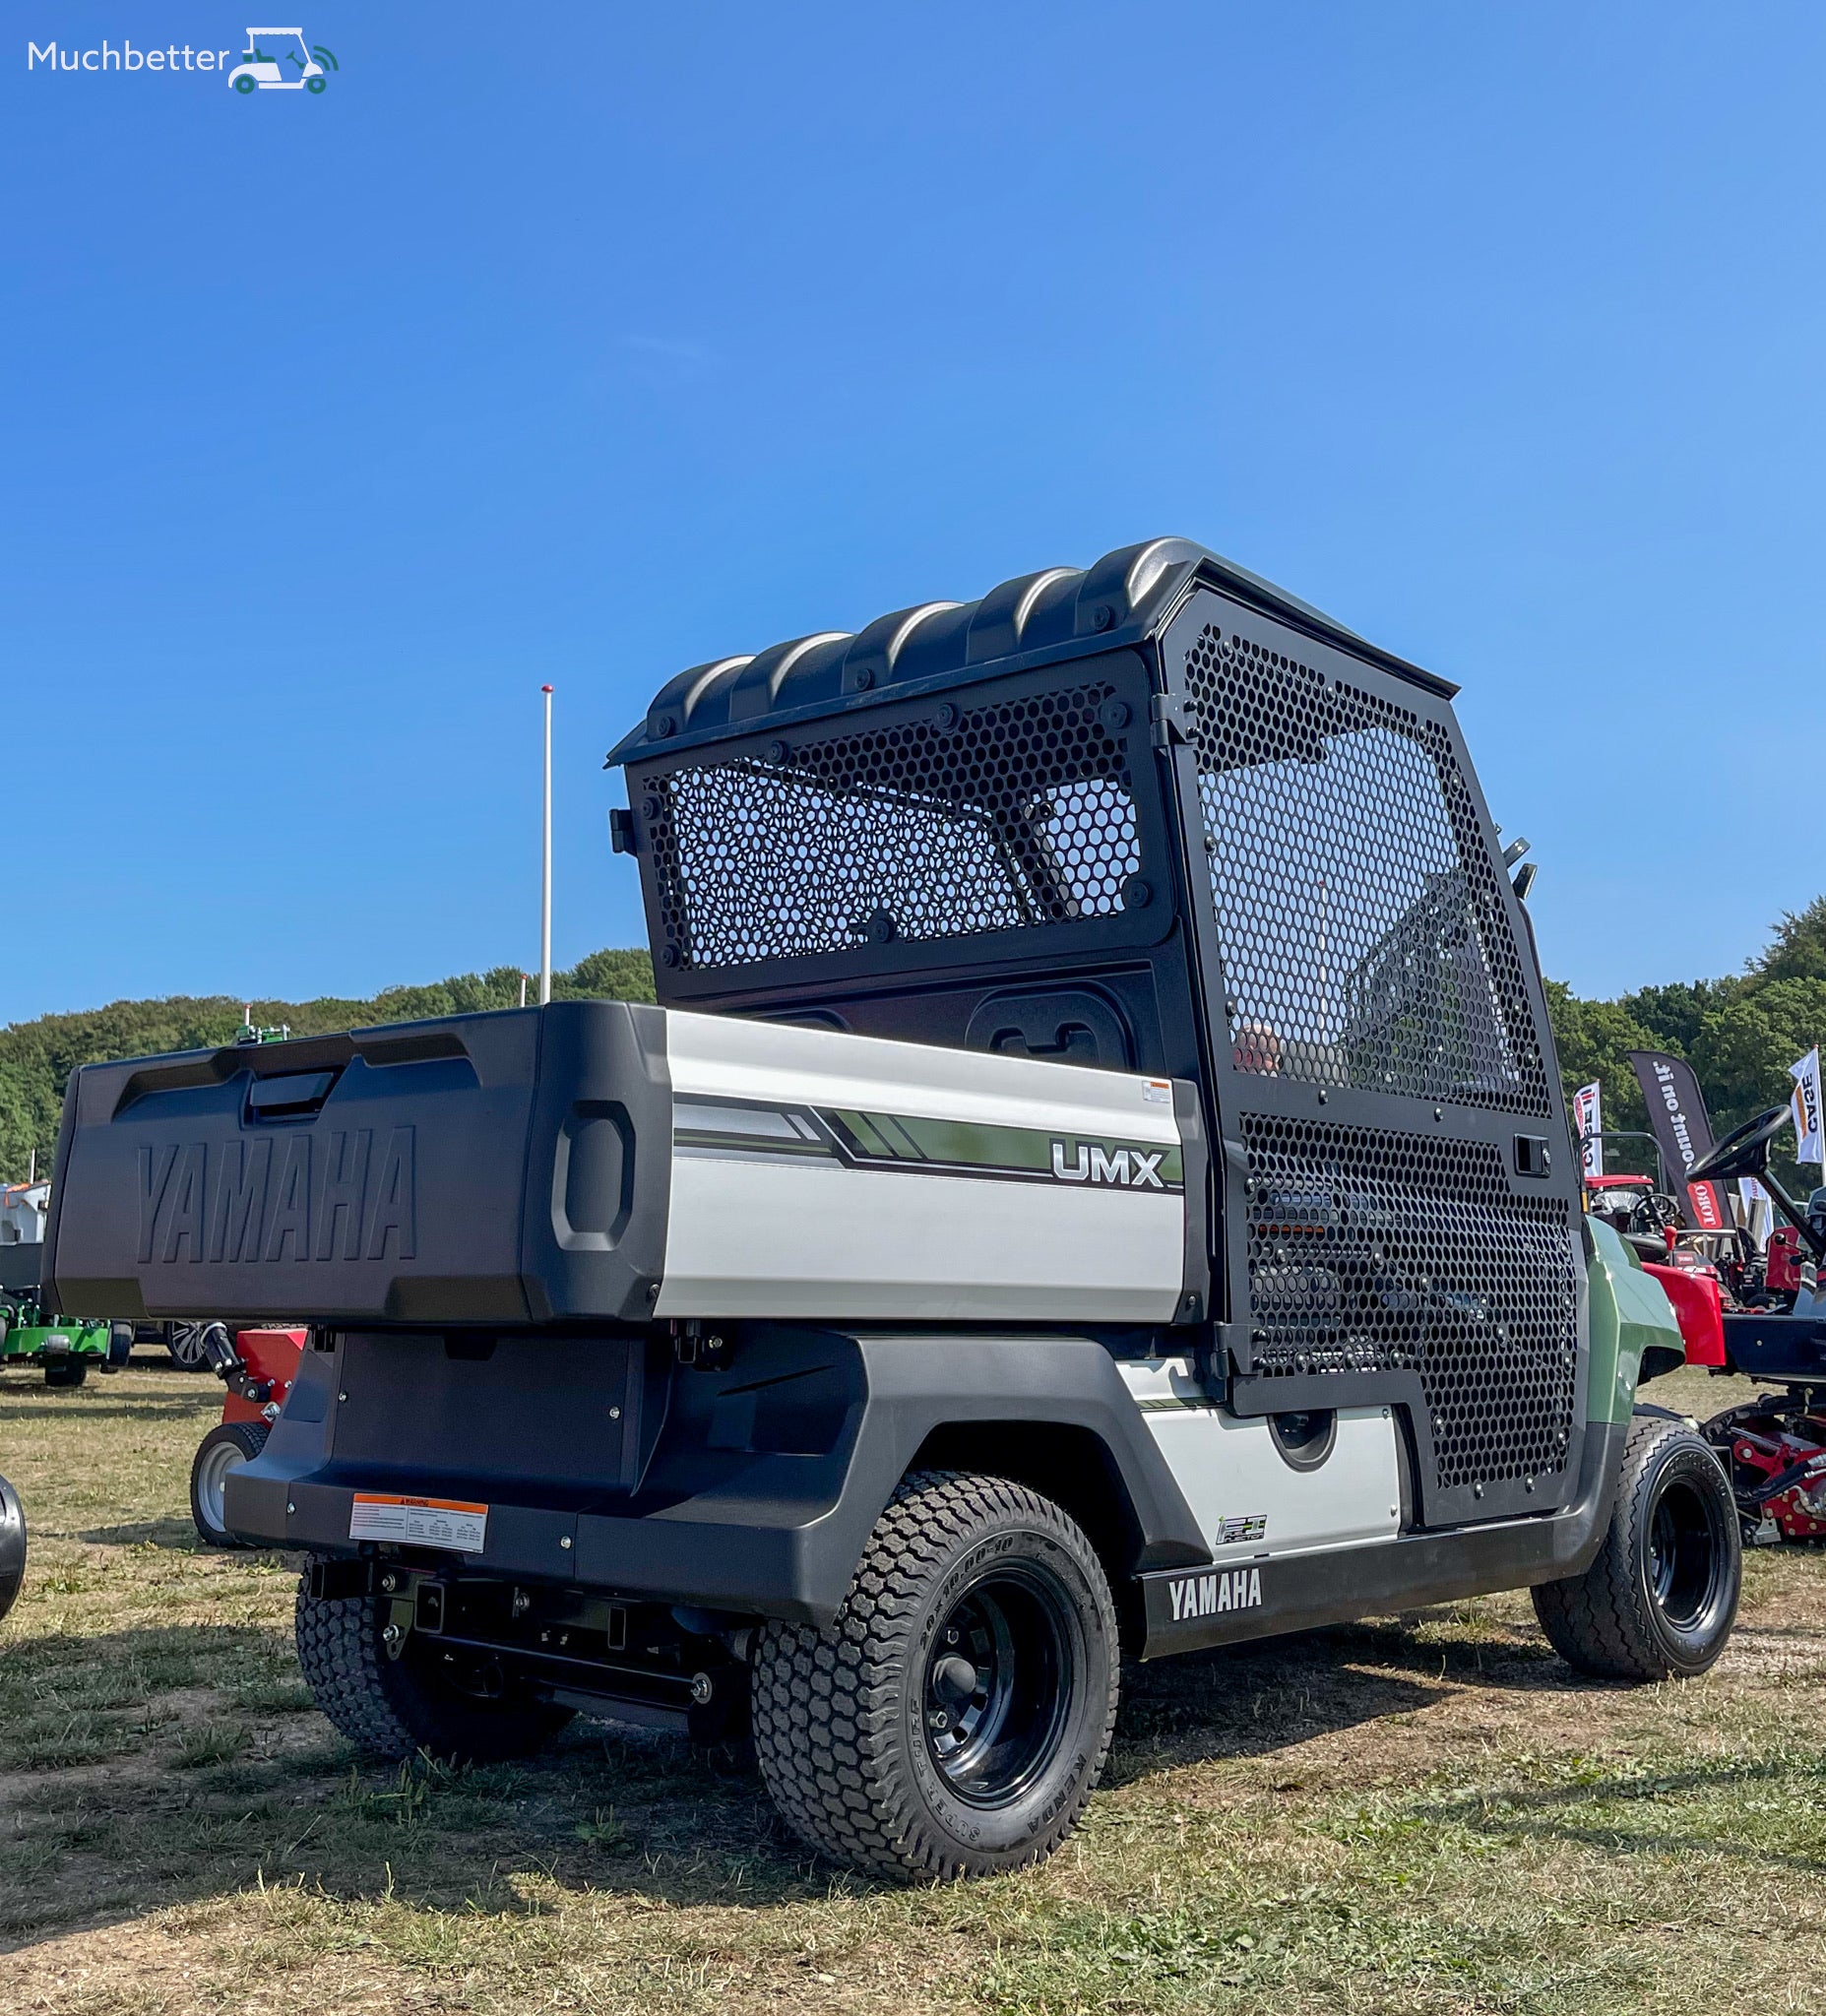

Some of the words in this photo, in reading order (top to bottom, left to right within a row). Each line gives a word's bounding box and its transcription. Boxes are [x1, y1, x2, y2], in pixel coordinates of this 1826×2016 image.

[136, 1125, 416, 1264] YAMAHA
[1052, 1143, 1165, 1188] UMX
[1168, 1568, 1262, 1621] YAMAHA
[1027, 1753, 1087, 1834] KENDA
